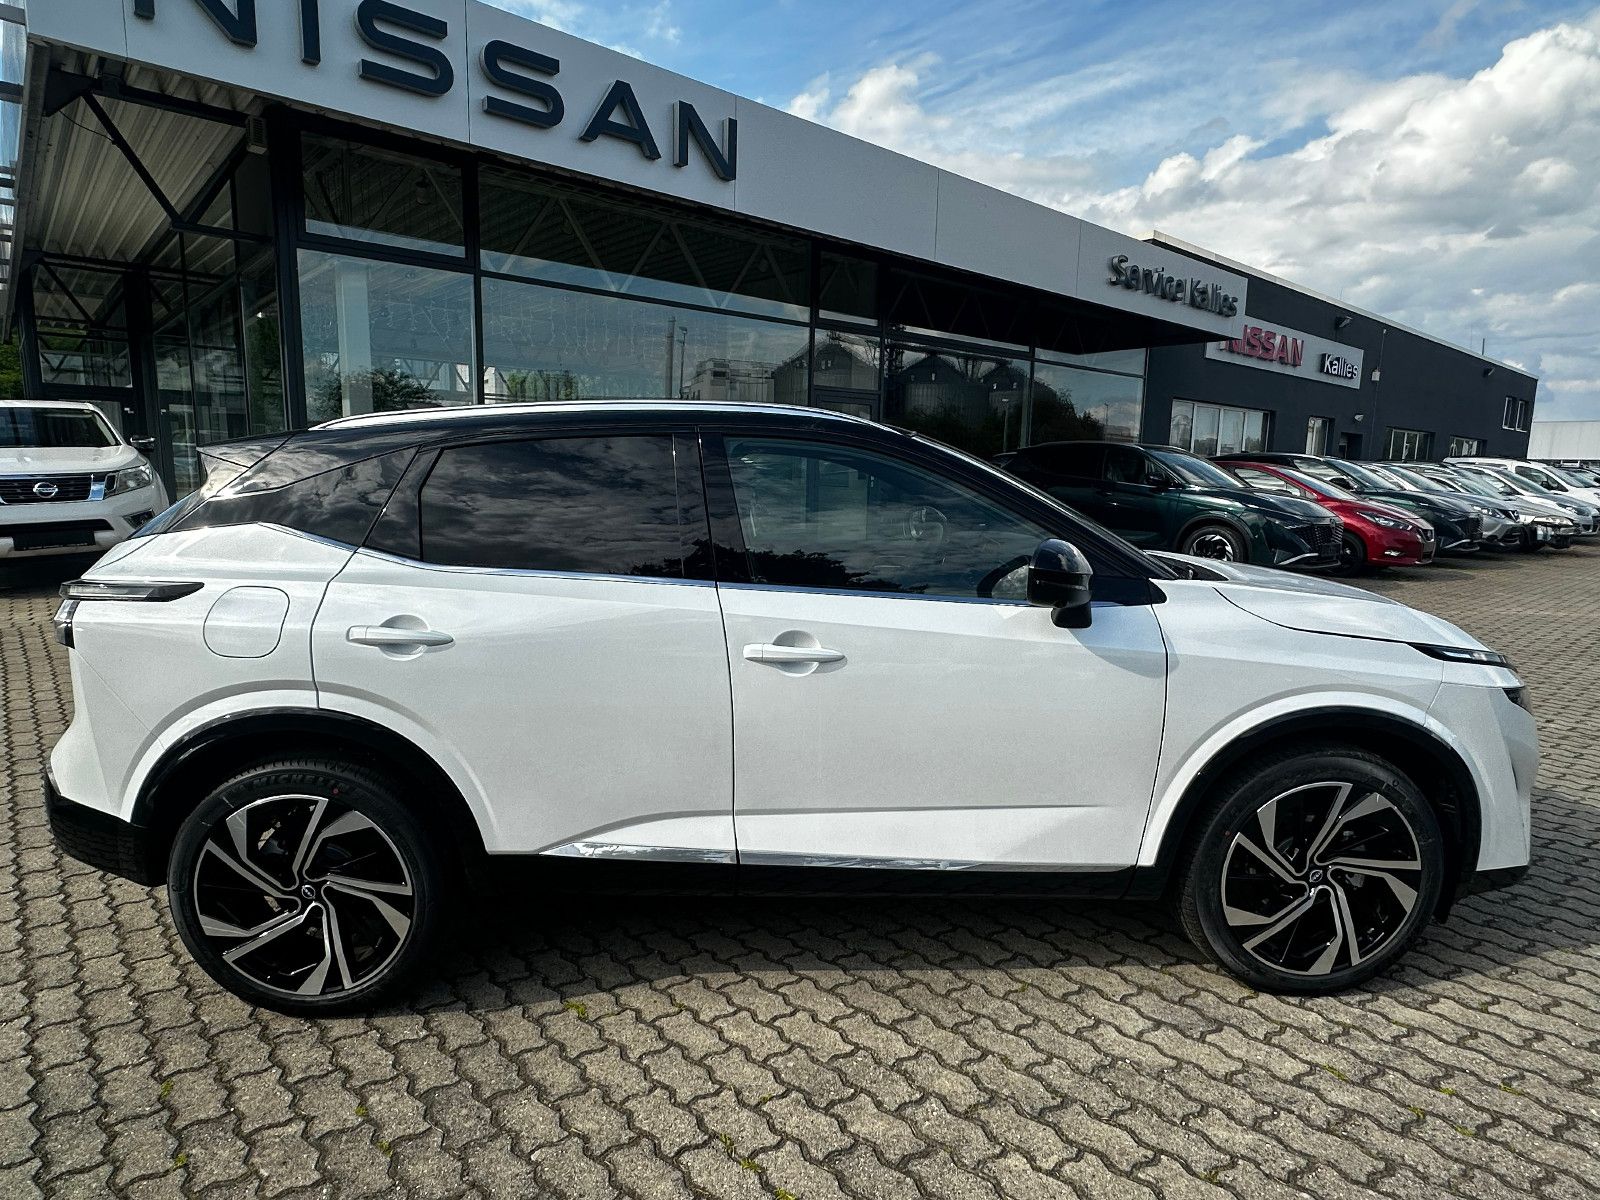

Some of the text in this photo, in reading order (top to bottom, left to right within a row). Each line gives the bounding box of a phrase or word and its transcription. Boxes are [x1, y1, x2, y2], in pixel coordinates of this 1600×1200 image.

[1109, 254, 1238, 317] Service Kallies
[1322, 353, 1358, 379] Kallies
